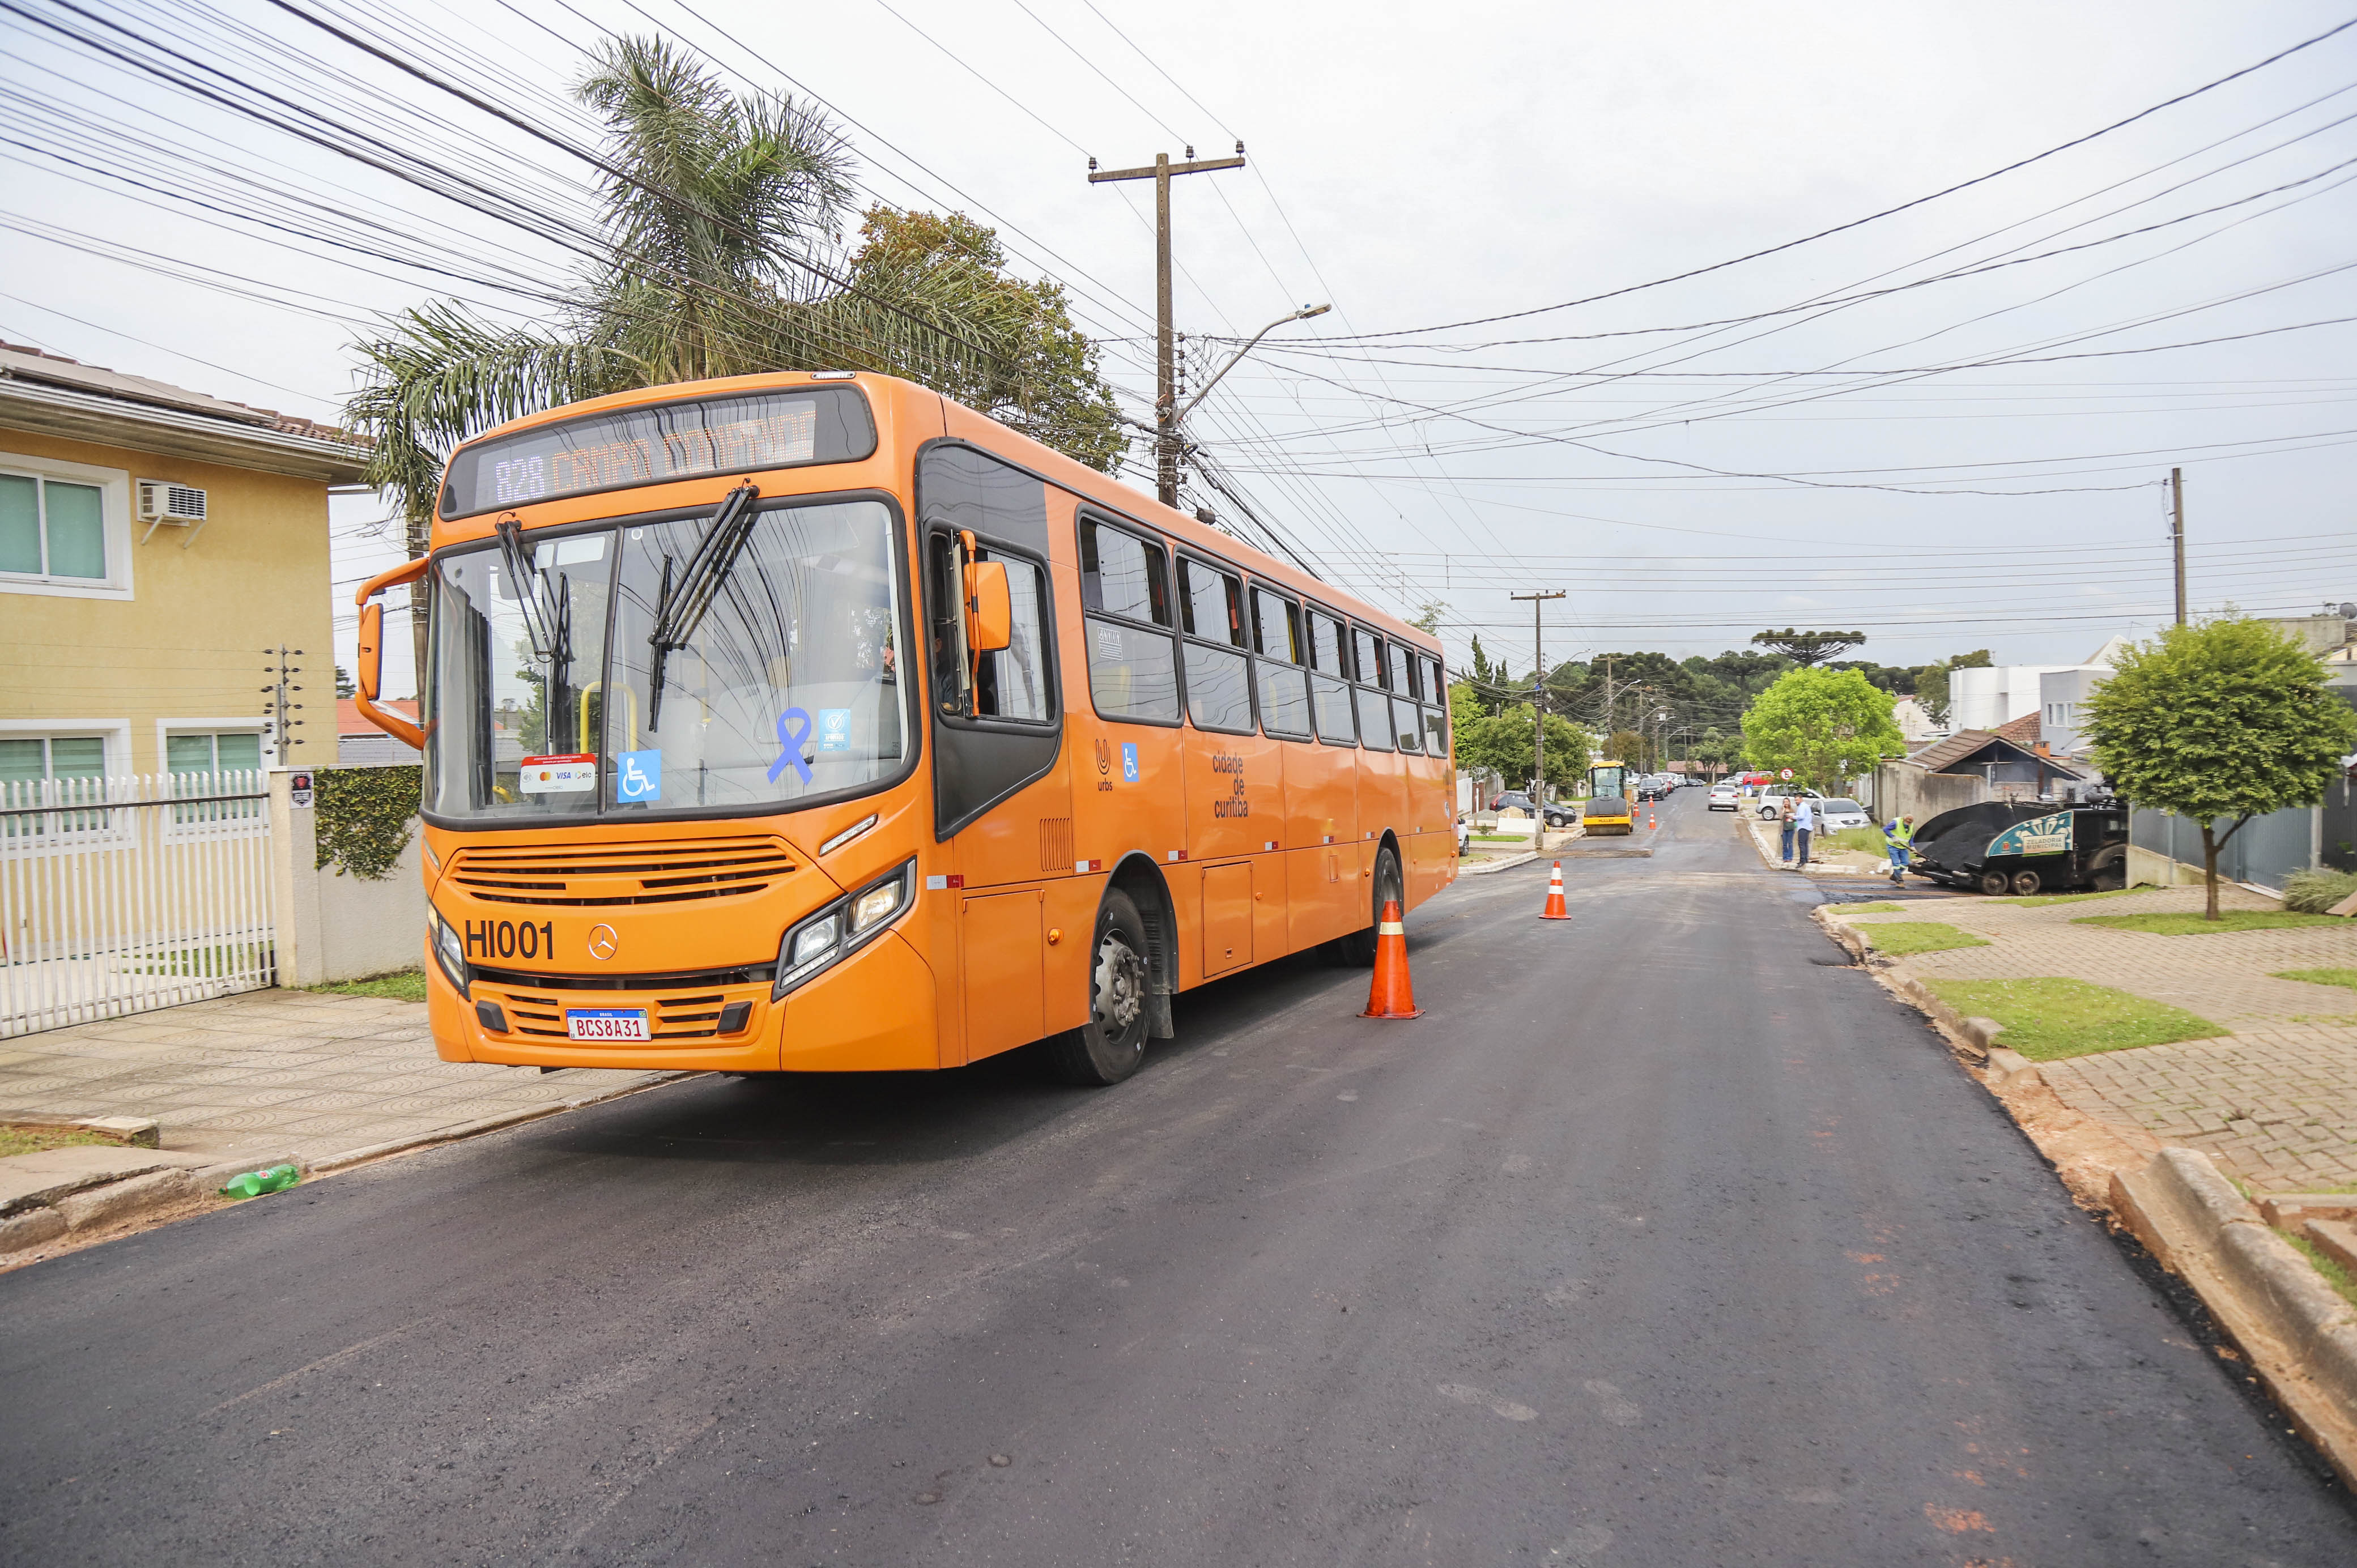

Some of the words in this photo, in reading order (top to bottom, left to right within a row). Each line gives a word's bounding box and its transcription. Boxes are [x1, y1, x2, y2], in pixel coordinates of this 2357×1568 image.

[496, 455, 544, 504] 828
[552, 438, 652, 492] CAMPO
[1212, 750, 1243, 774] cidade
[1097, 777, 1113, 791] urbs
[1233, 773, 1244, 796] de
[1214, 795, 1248, 819] curitiba
[465, 920, 554, 960] HI001
[576, 1020, 641, 1037] BCS8A31
